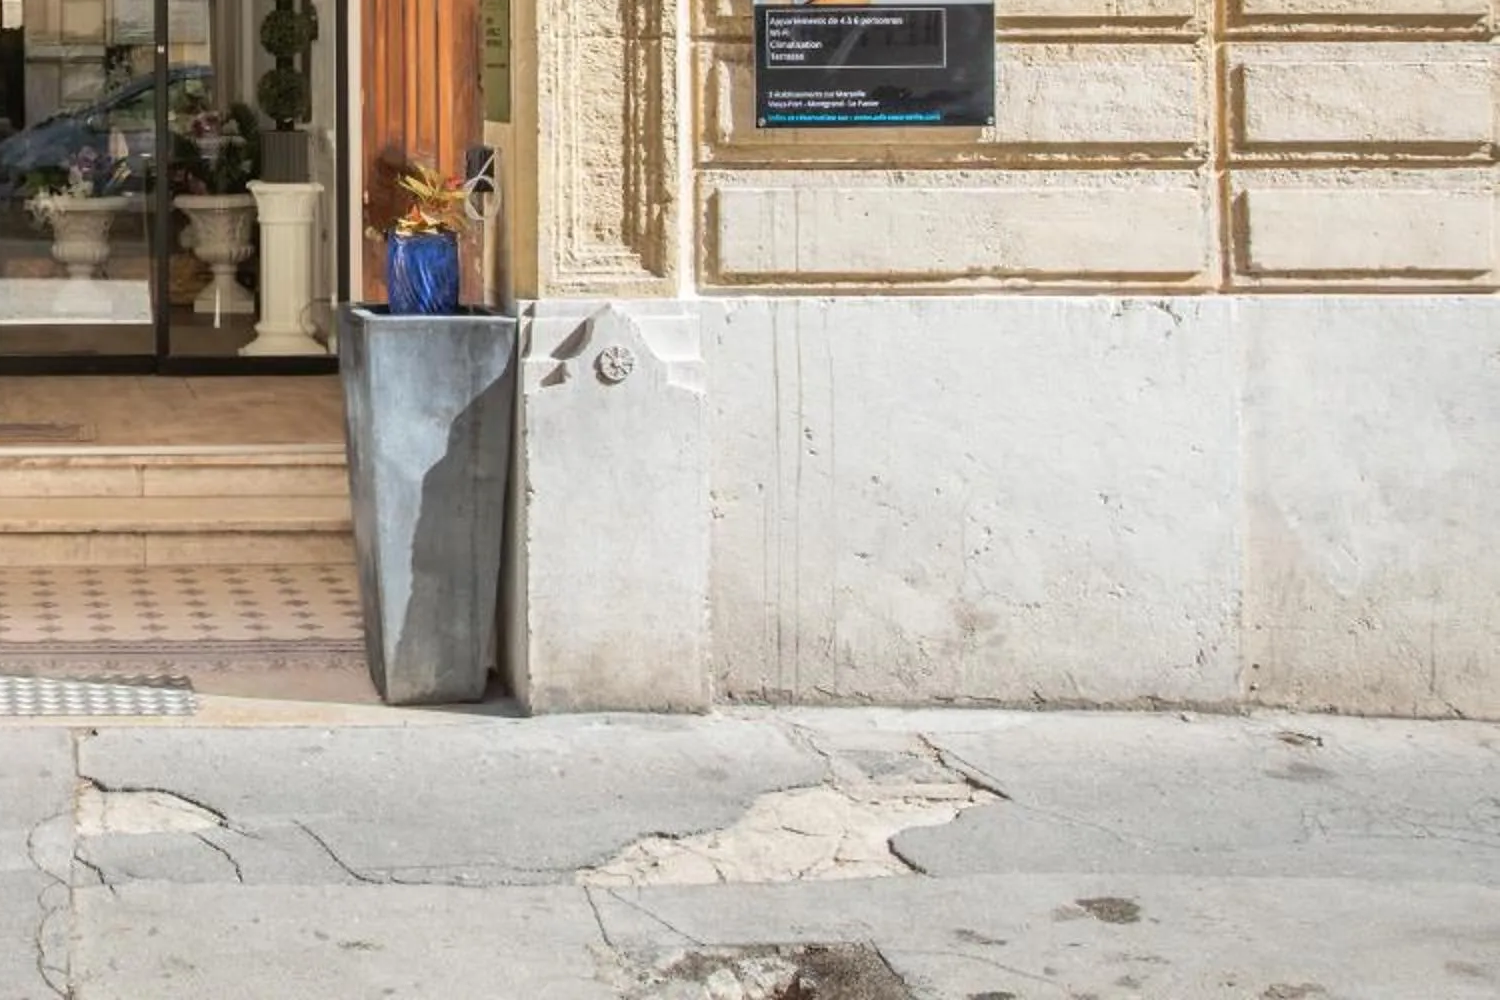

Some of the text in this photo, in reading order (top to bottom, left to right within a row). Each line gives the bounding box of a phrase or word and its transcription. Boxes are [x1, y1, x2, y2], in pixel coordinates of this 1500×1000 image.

[769, 16, 827, 26] Appartements
[828, 17, 838, 25] de
[839, 17, 845, 25] 4
[860, 16, 903, 26] personnes
[769, 40, 823, 49] Climatisation
